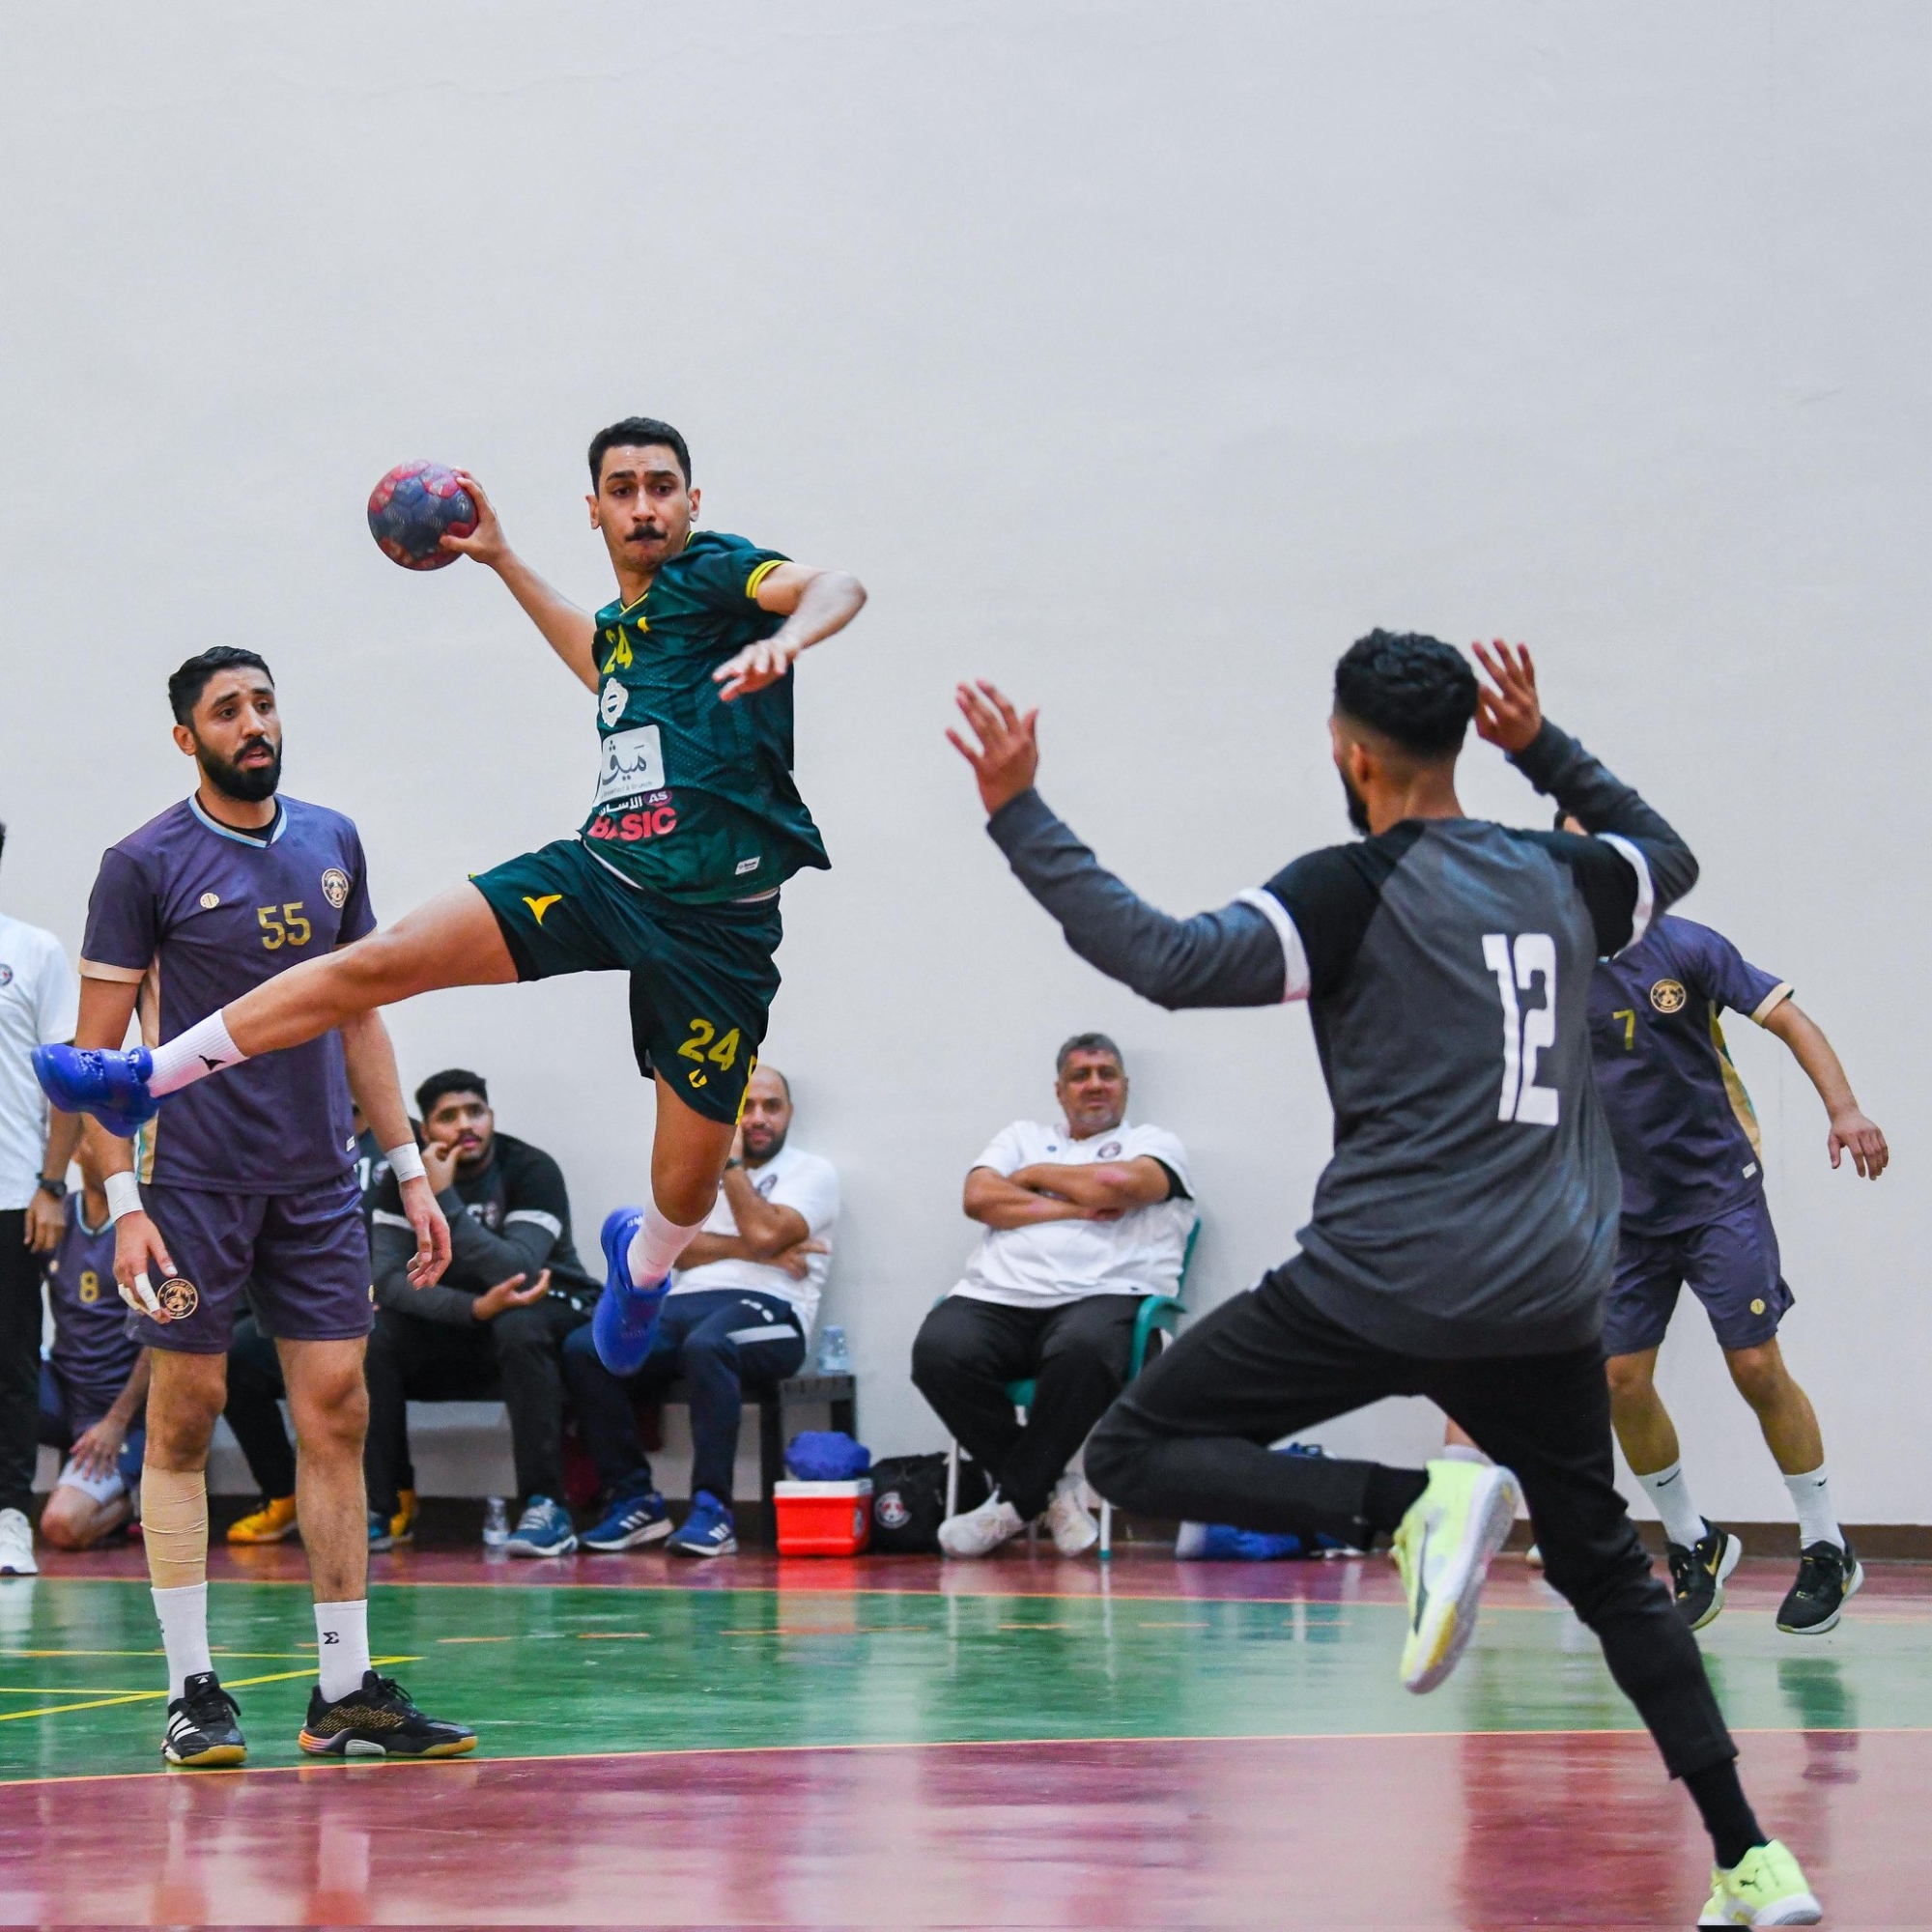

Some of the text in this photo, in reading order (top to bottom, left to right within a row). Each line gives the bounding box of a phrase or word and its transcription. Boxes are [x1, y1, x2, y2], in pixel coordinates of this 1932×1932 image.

[602, 623, 633, 674] 24
[648, 791, 668, 804] AS
[257, 901, 311, 951] 55
[677, 1018, 740, 1071] 24
[1482, 932, 1560, 1126] 12
[1612, 1009, 1635, 1051] 7
[79, 1270, 99, 1303] 8
